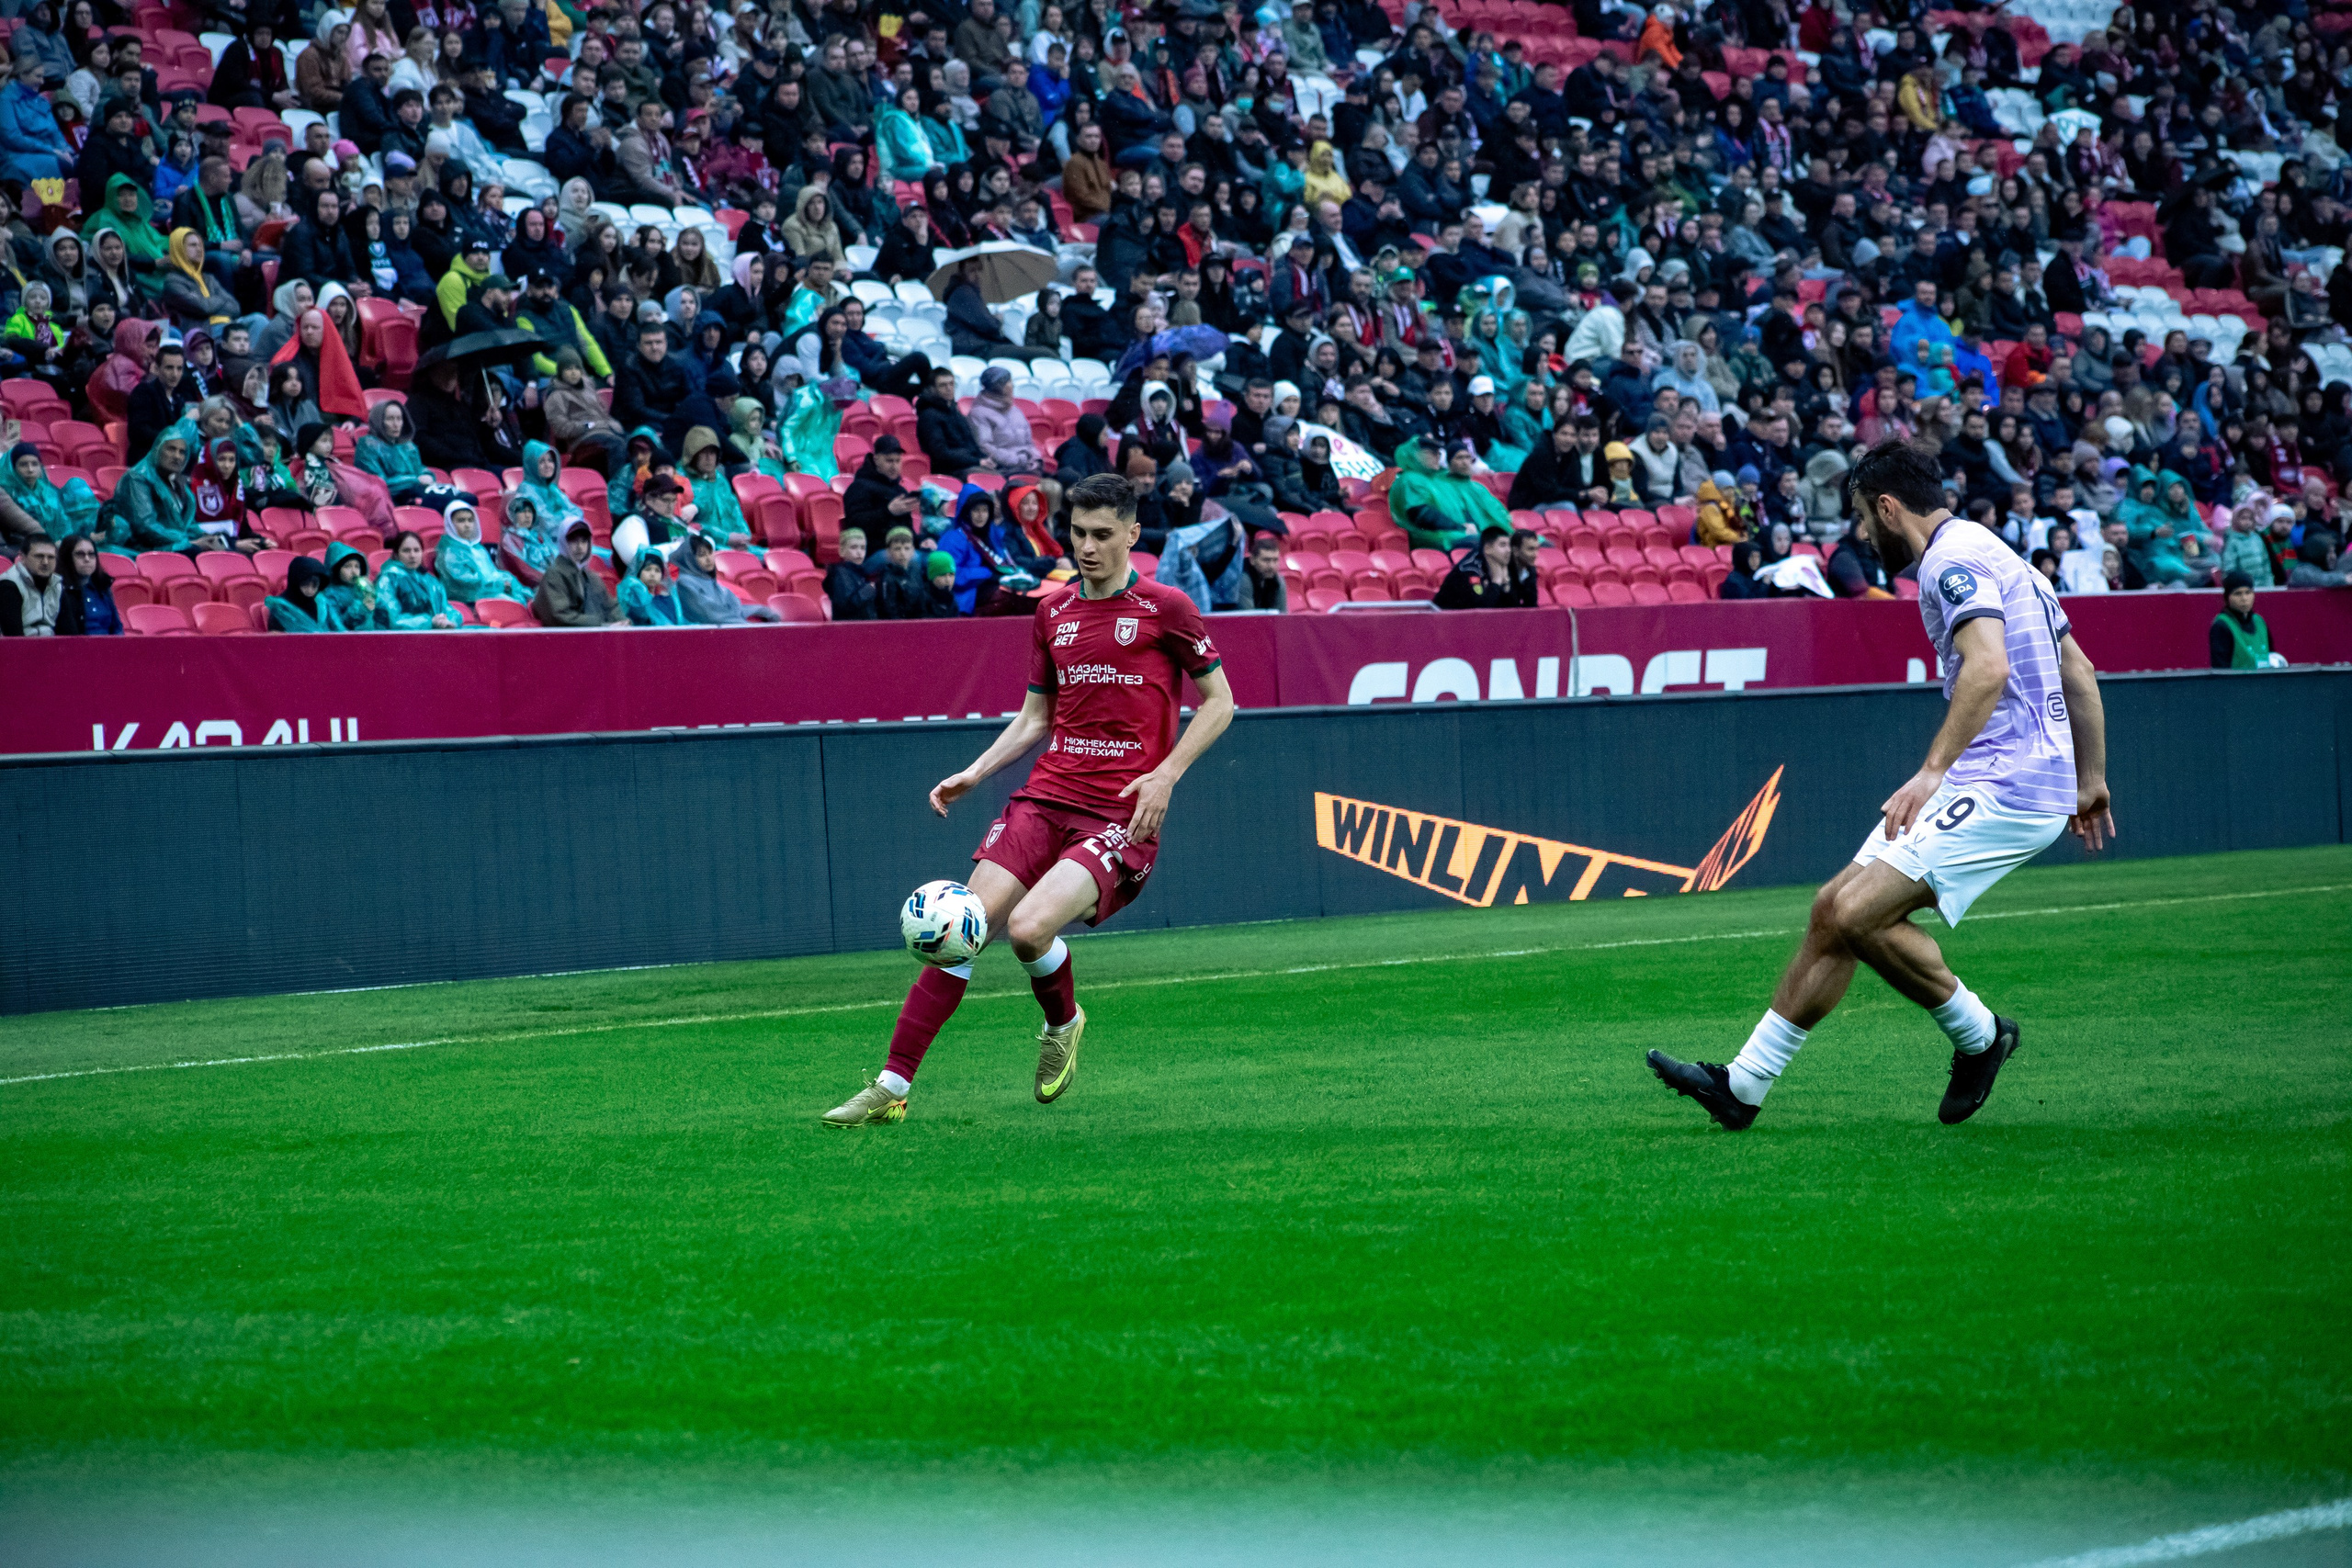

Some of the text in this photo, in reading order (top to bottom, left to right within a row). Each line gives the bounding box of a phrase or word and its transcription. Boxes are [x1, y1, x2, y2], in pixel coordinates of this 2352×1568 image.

[1949, 583, 1974, 602] LADA
[1056, 621, 1080, 635] FON
[1053, 633, 1079, 647] BET
[1067, 664, 1117, 674] КАЗАНЬ
[1069, 673, 1143, 685] ОРГСИНТЕЗ
[1064, 736, 1142, 750] НИЖНЕКАМСК
[1063, 744, 1125, 758] НЕФТЕХИМ
[1331, 797, 1692, 907] WINLIN
